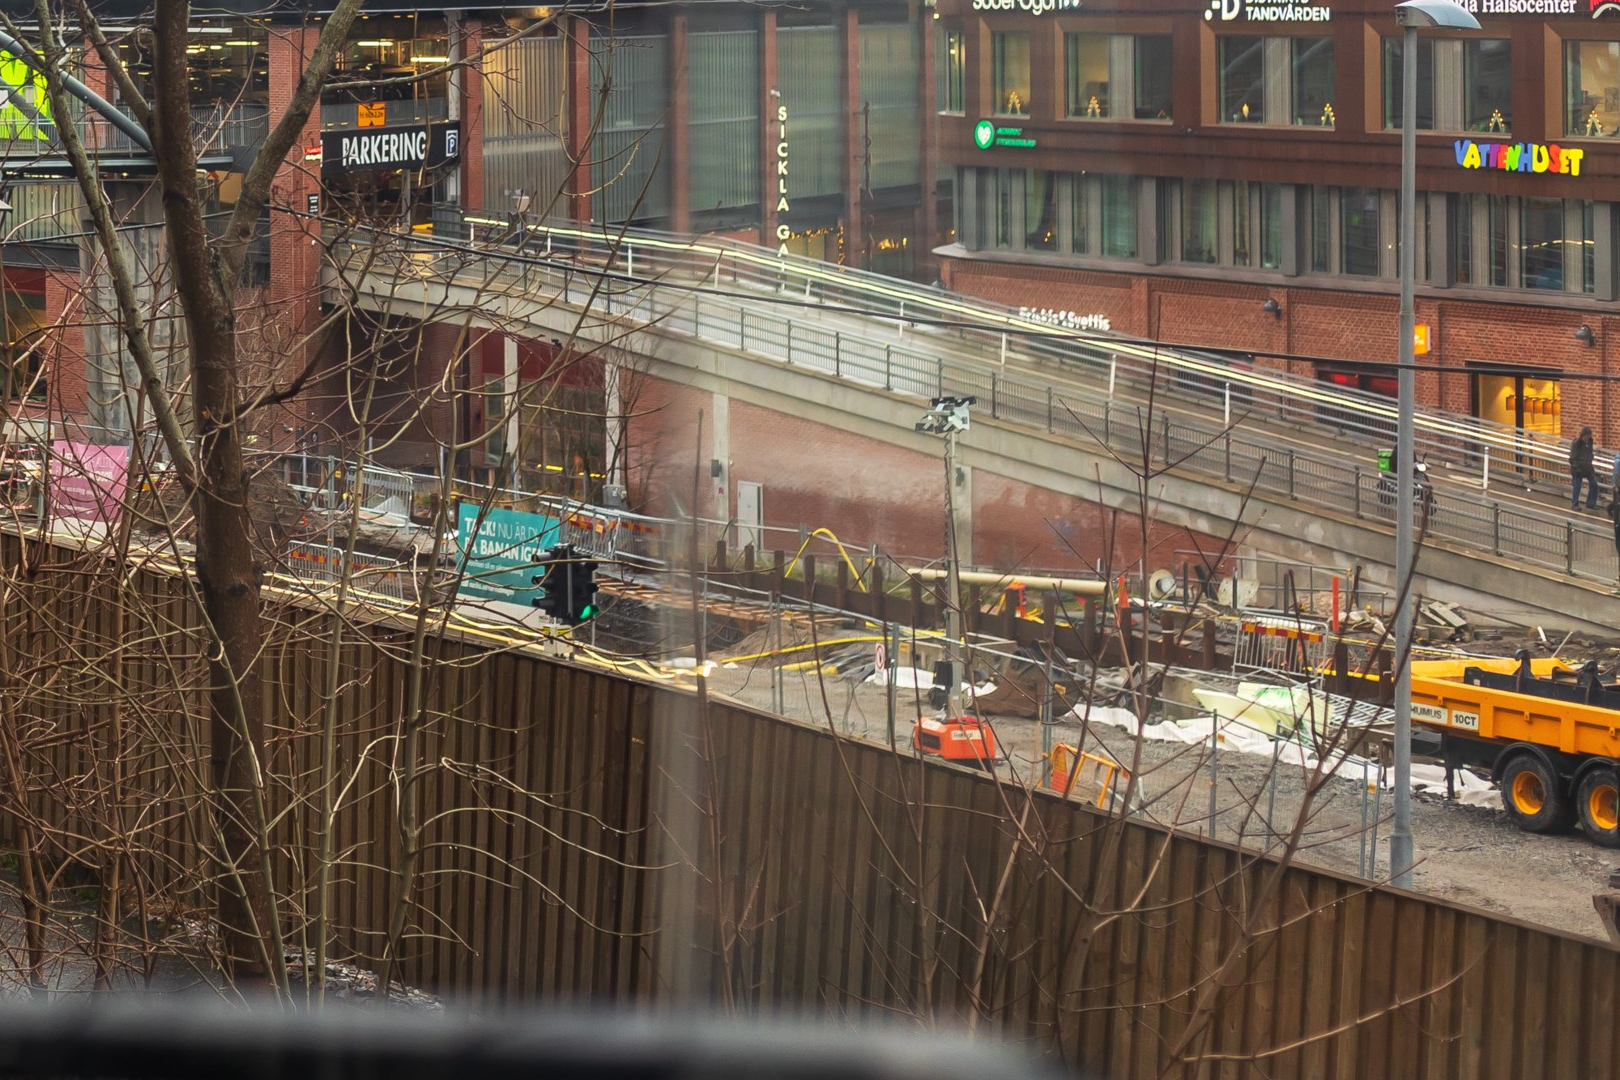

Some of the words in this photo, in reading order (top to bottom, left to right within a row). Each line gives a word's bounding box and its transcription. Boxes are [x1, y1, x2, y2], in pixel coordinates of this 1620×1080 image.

[1245, 3, 1330, 21] TANDVÅRDEN
[342, 131, 427, 167] PARKERING
[776, 106, 790, 212] SICKLA
[1454, 139, 1584, 176] VATTENHUSET
[498, 522, 513, 539] NU
[514, 522, 526, 539] ÄR
[480, 539, 520, 561] BANAN
[1454, 713, 1477, 727] 10CT
